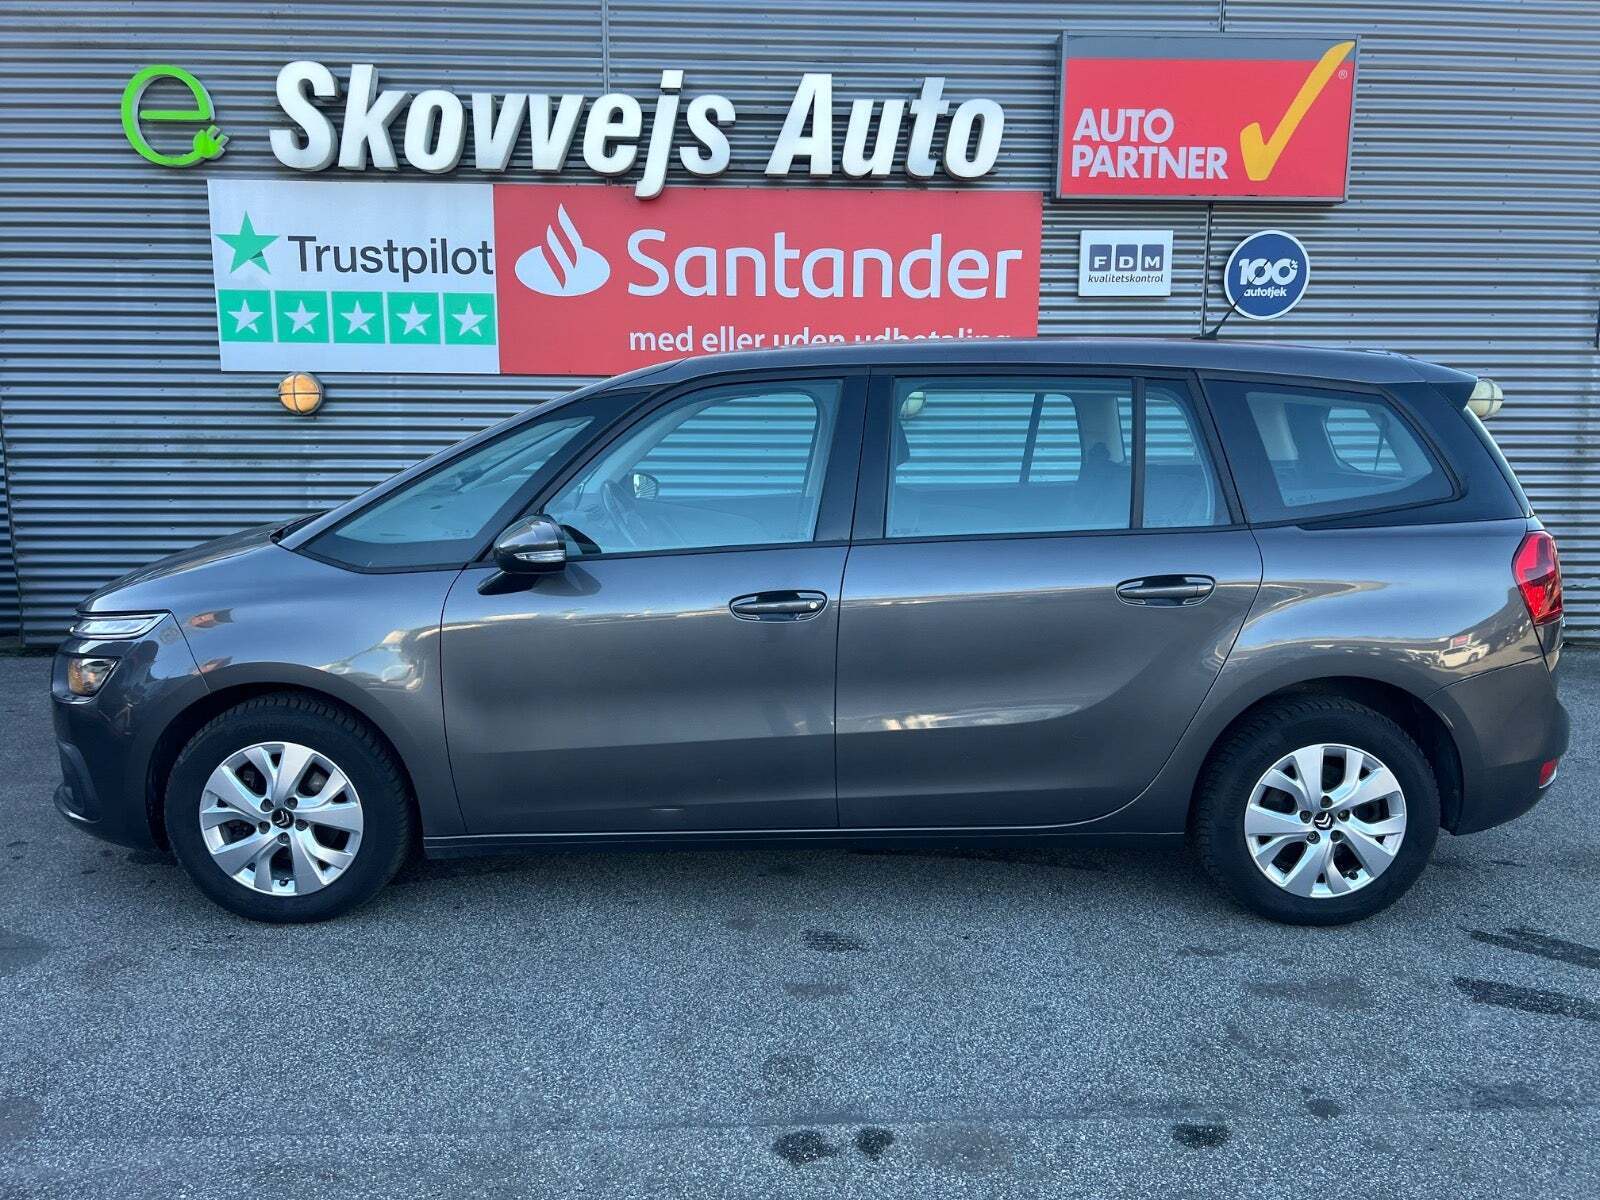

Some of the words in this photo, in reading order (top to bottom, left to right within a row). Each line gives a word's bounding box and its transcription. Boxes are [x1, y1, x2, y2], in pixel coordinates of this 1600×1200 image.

[269, 60, 736, 199] Skovvejs
[764, 73, 1006, 180] Auto
[1072, 108, 1175, 143] AUTO
[1071, 145, 1229, 180] PARTNER
[287, 235, 494, 283] Trustpilot
[627, 229, 1022, 299] Santander
[1093, 255, 1161, 269] FDM
[1088, 274, 1164, 283] kvalitetskontrol
[1243, 286, 1288, 299] autotjek
[629, 325, 694, 352] med
[702, 326, 766, 352] eller
